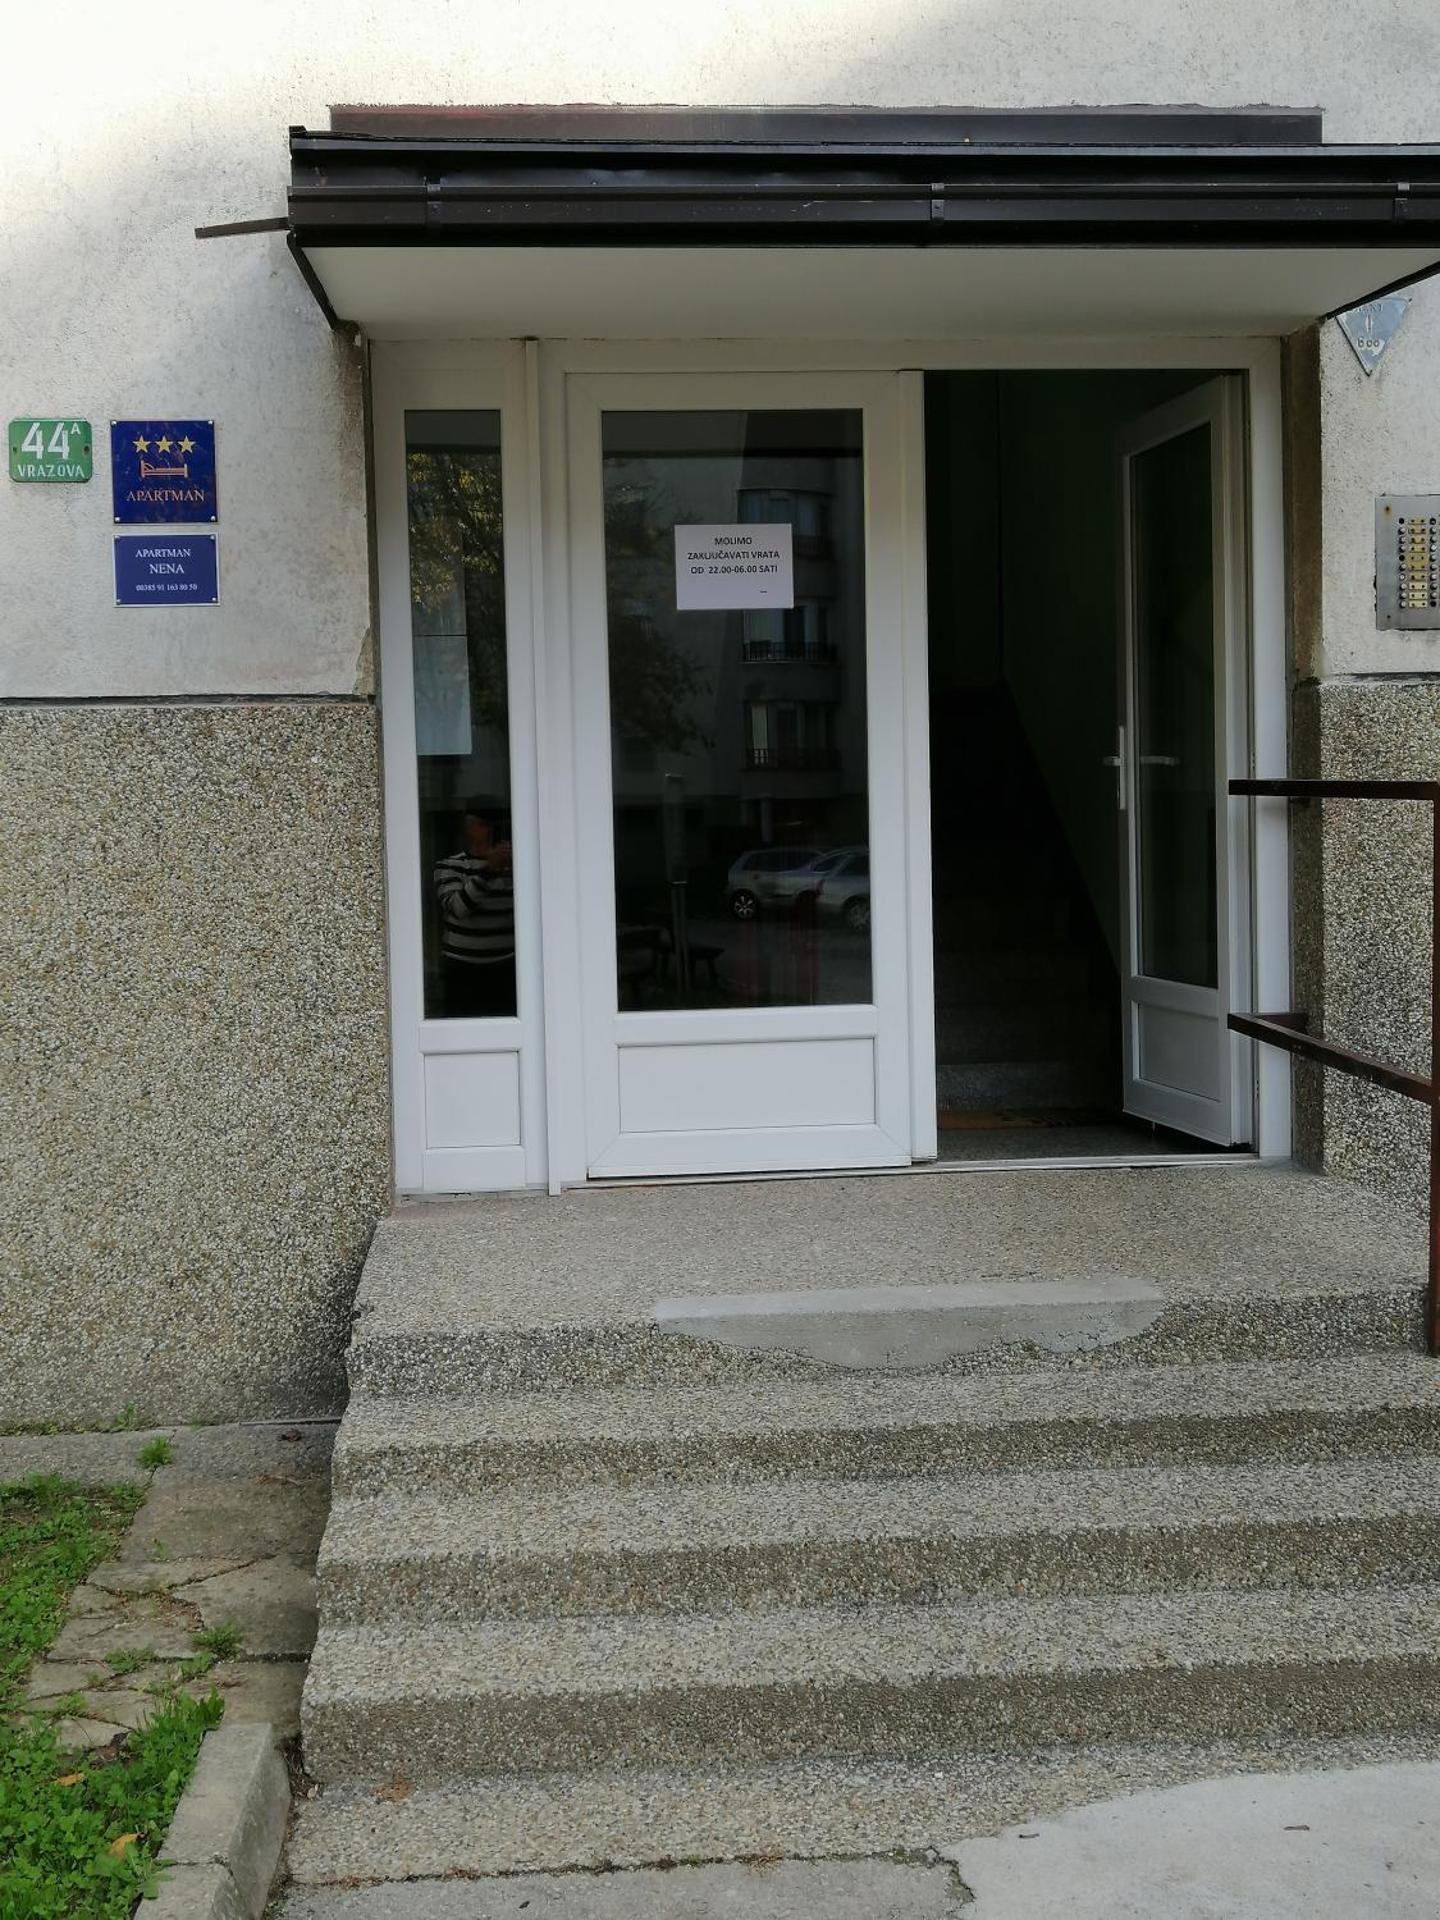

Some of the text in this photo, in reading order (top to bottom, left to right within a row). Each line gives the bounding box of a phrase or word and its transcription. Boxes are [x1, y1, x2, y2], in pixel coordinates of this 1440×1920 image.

[17, 464, 85, 478] VRAZOVA
[126, 489, 205, 502] APARTMAN
[714, 537, 752, 545] MOLIMO
[135, 548, 191, 558] APARTMAN
[751, 550, 780, 559] VRATA
[149, 563, 185, 574] NENA
[690, 565, 778, 574] OD 22.00-06.00 SATI
